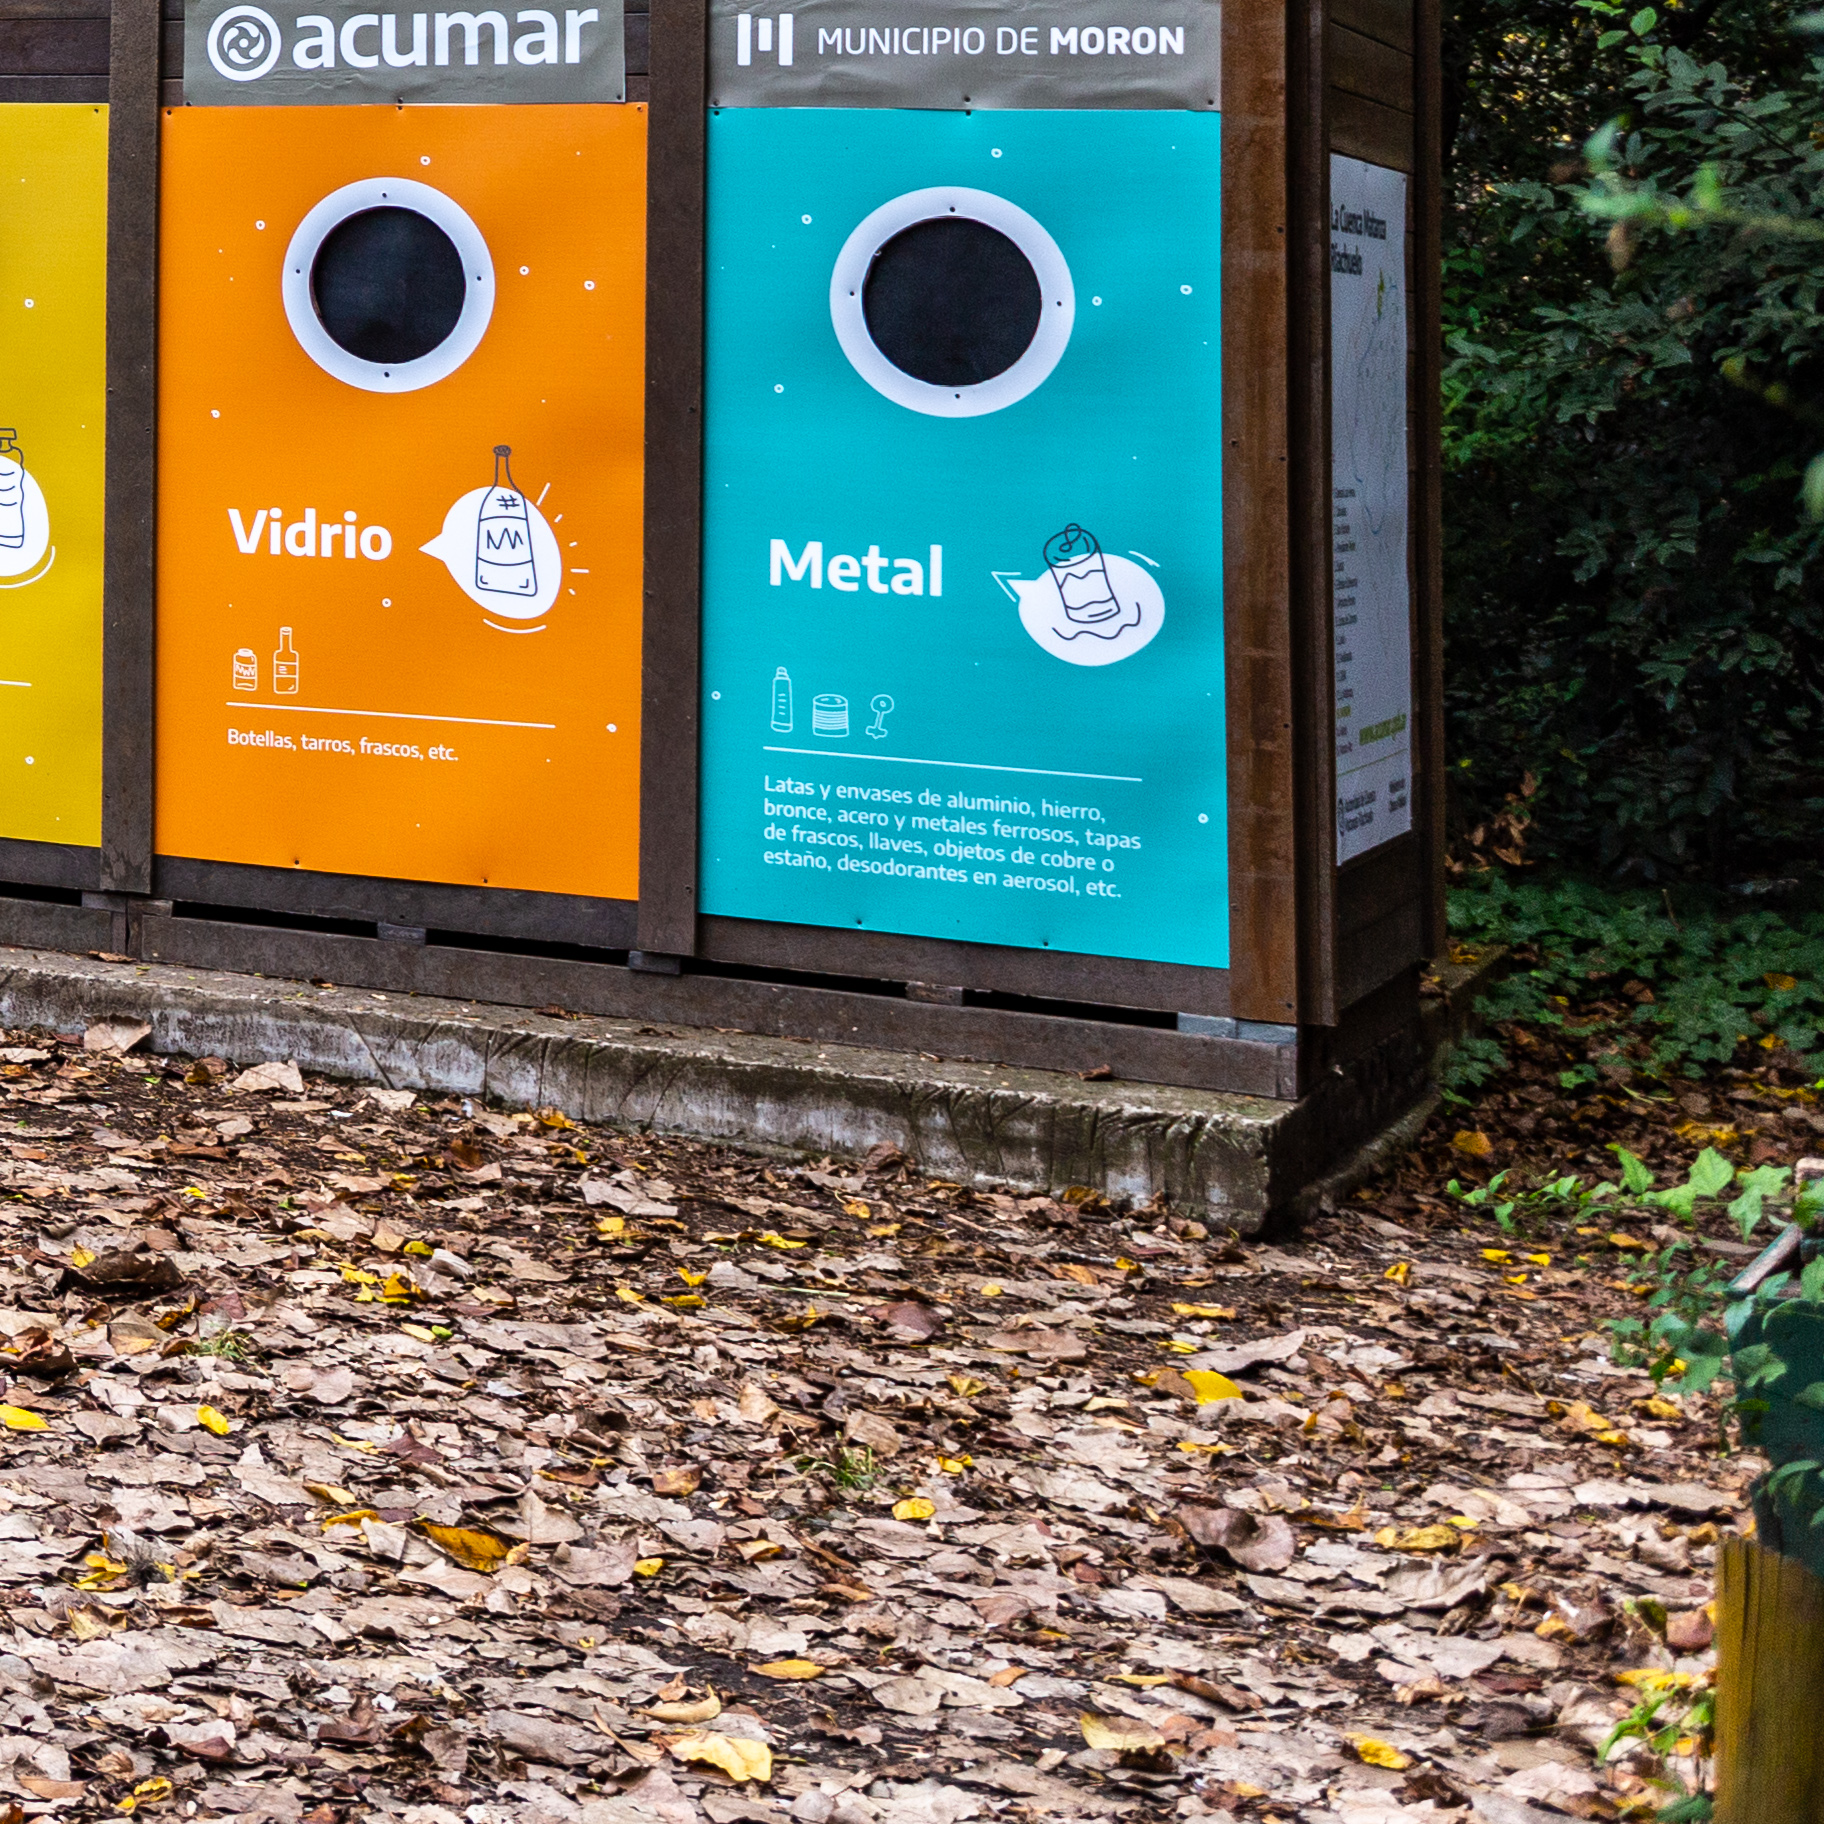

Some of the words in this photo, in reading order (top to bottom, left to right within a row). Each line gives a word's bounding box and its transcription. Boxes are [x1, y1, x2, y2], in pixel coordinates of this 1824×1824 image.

[293, 9, 598, 69] acumar
[819, 28, 984, 54] MUNICIPIO
[997, 27, 1038, 54] DE
[1051, 27, 1184, 54] MORON
[228, 508, 392, 560] Vidrio
[770, 539, 942, 596] Metal
[228, 729, 296, 751] Botellas,
[301, 735, 355, 755] tarros,
[359, 737, 423, 760] frascos,
[428, 744, 458, 761] etc.
[764, 775, 814, 795] Latas
[820, 784, 830, 800] y
[836, 785, 912, 804] envases
[918, 788, 941, 807] de
[947, 792, 1035, 817] aluminio,
[1042, 799, 1105, 823] hierro,
[764, 798, 831, 823] bronce,
[838, 810, 888, 826] acero
[894, 815, 905, 831] y
[912, 816, 987, 835] metales
[992, 819, 1079, 845] ferrosos,
[1085, 829, 1141, 851] tapas
[764, 823, 786, 840] de
[791, 825, 863, 850] frascos,
[869, 832, 927, 856] llaves,
[934, 839, 1005, 861] objetos
[1011, 846, 1035, 864] de
[1041, 850, 1096, 870] cobre
[1102, 859, 1114, 872] o
[764, 850, 831, 871] estaño,
[837, 854, 968, 882] desodorantes
[973, 872, 996, 885] en
[1003, 874, 1080, 896] aerosol,
[1086, 880, 1121, 897] etc.
